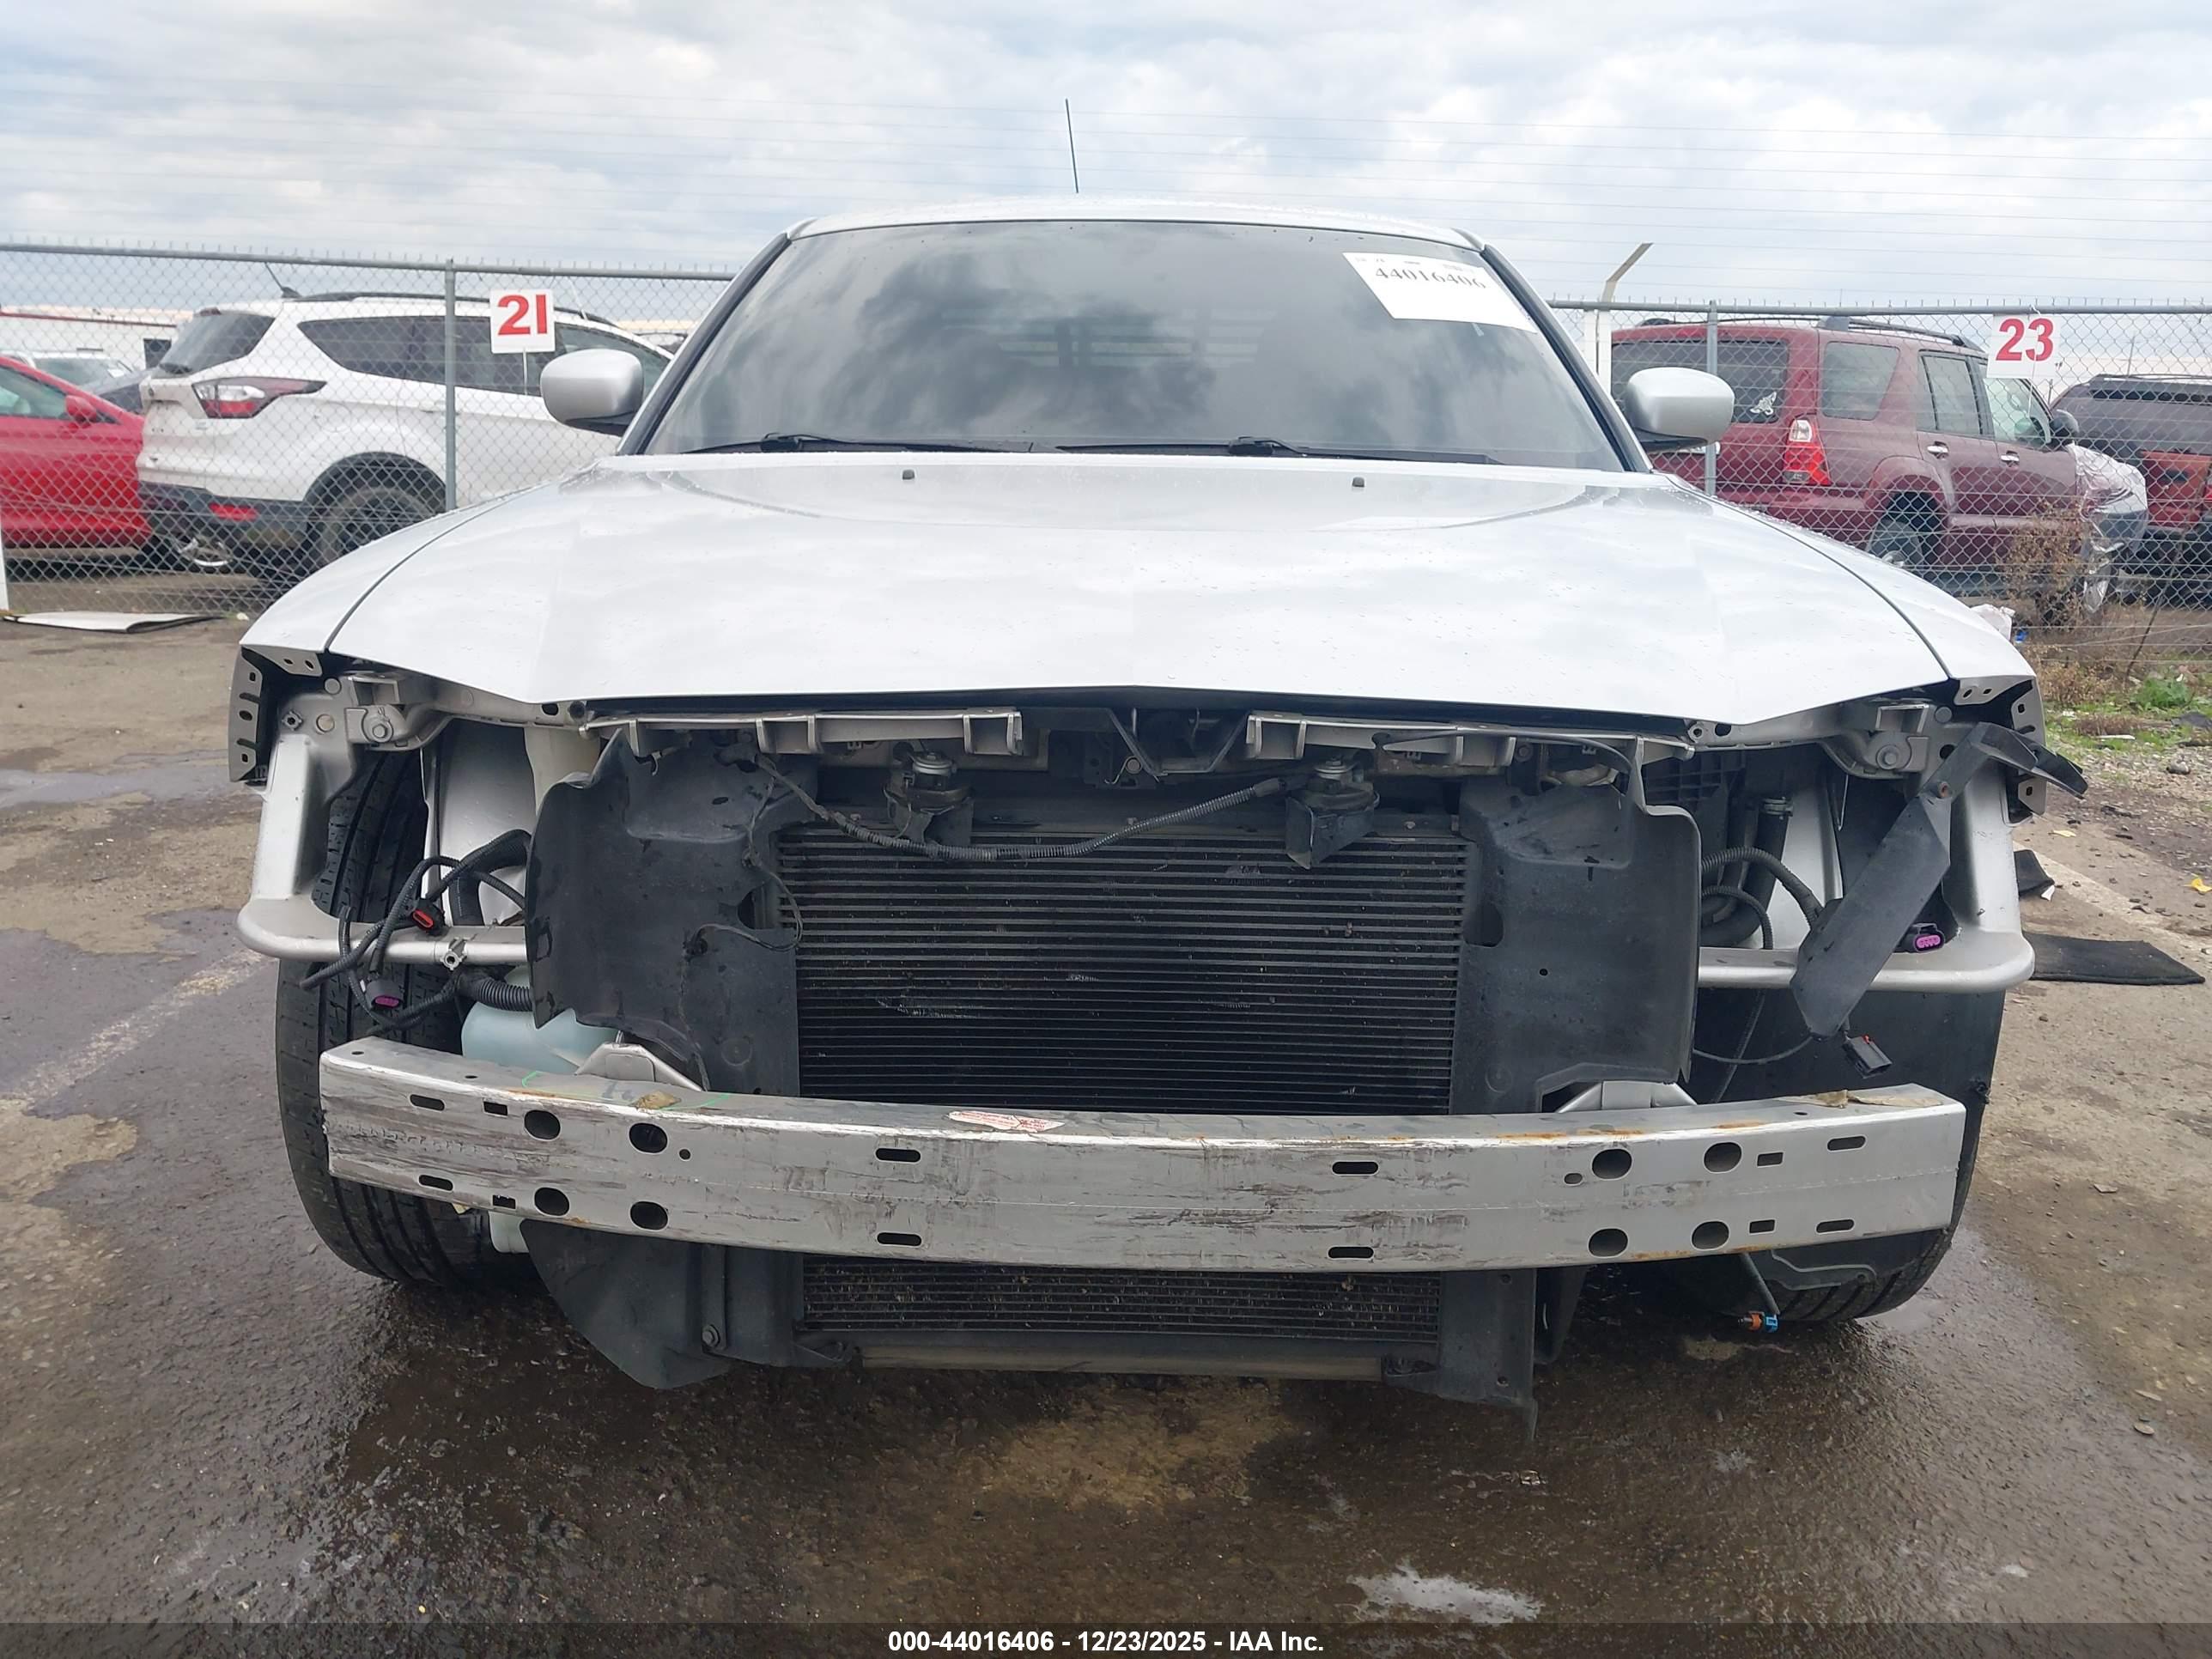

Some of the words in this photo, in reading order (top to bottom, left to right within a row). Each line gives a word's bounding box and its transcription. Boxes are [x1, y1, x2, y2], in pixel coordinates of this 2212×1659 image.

[1376, 267, 1486, 289] 44016406
[497, 294, 548, 336] 21
[1996, 318, 2053, 362] 23
